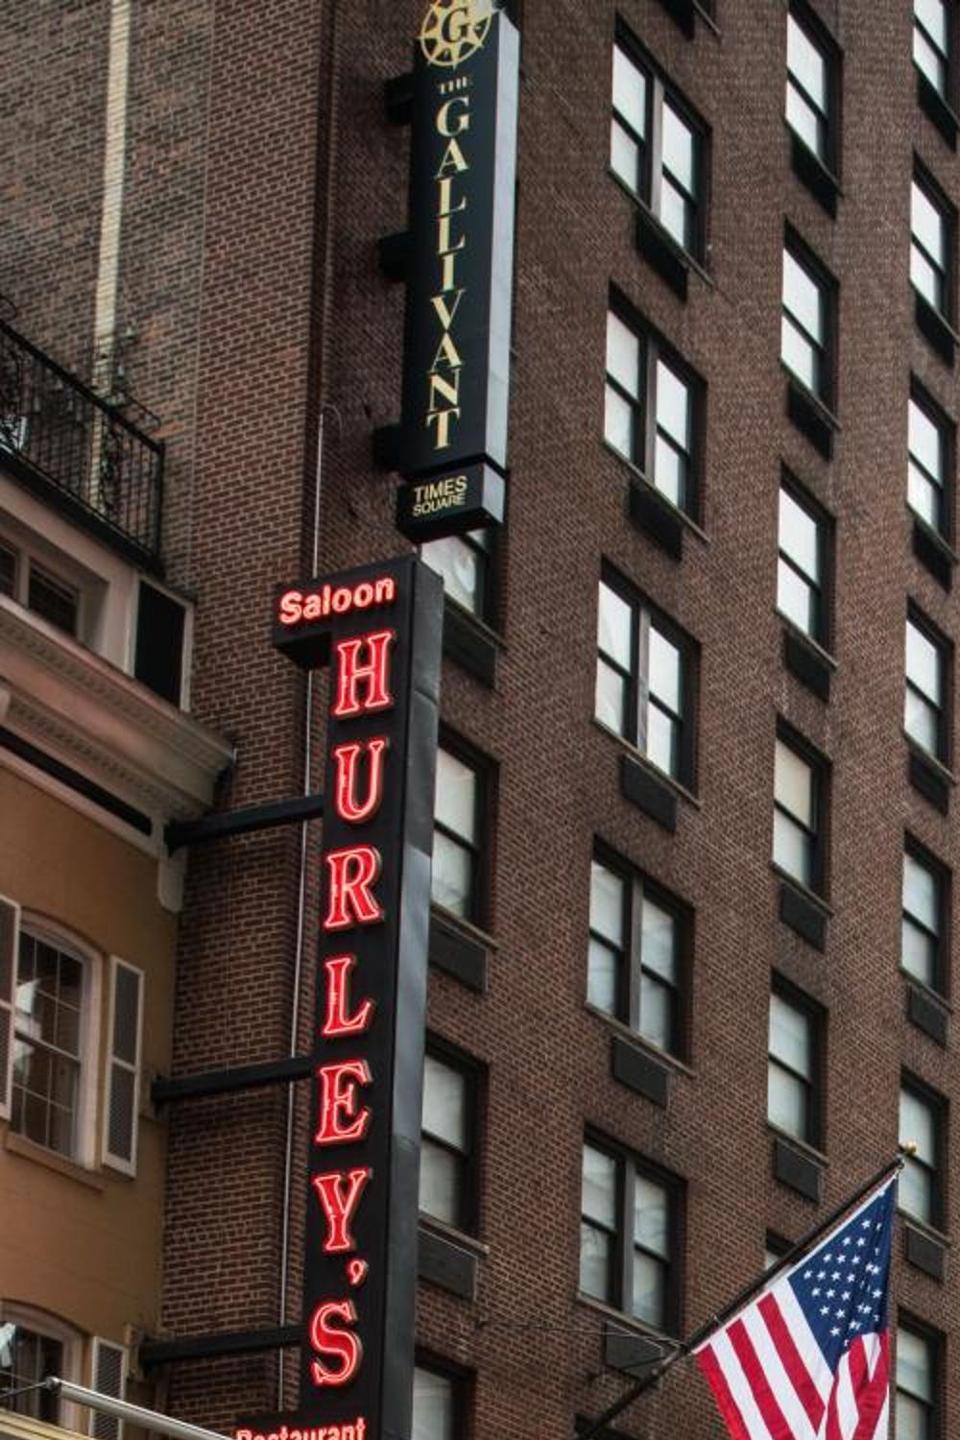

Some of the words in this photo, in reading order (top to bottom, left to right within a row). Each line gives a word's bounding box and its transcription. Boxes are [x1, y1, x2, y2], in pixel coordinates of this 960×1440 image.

[427, 97, 470, 450] GALLIVANT
[413, 475, 468, 503] TIMES
[413, 493, 466, 517] SQUARE
[279, 577, 395, 625] Saloon
[309, 630, 396, 1388] HURLEY'S
